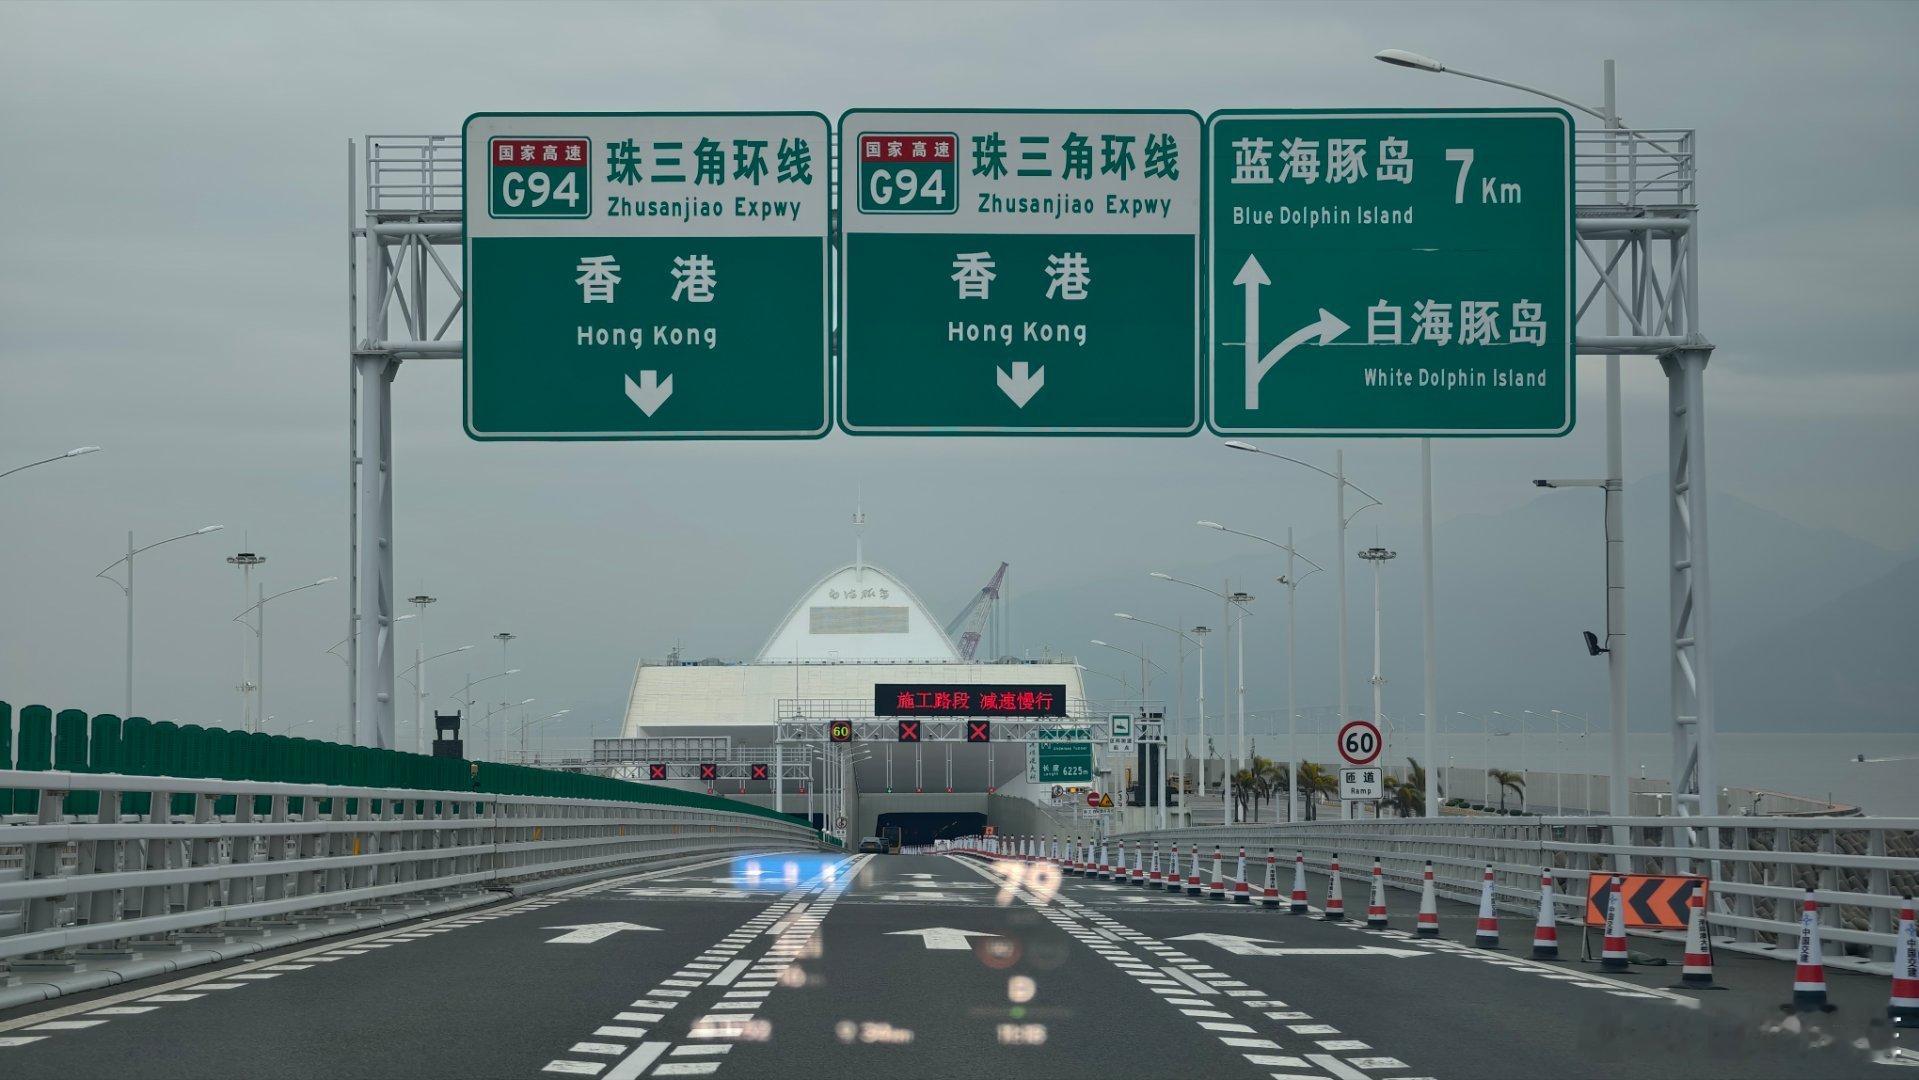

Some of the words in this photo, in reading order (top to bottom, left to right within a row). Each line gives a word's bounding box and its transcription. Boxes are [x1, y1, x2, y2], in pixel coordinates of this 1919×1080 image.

[499, 145, 581, 161] 国家高速
[607, 137, 812, 185] 珠三角环线
[866, 141, 950, 158] 国家高速
[972, 132, 1179, 181] 珠三角环线
[1231, 136, 1413, 184] 蓝海豚岛
[871, 169, 945, 204] G94
[1446, 149, 1473, 204] 7
[1483, 177, 1521, 203] Km
[503, 172, 579, 207] G94
[608, 197, 722, 222] Zhusanjiao
[736, 197, 800, 221] Expwy
[979, 193, 1093, 219] Zhusanjiao
[1107, 195, 1170, 218] Expwy
[1234, 207, 1273, 224] Blue
[1281, 206, 1349, 228] Dolphin
[1358, 206, 1412, 224] Island
[575, 255, 717, 303] 香港
[951, 252, 1090, 299] 香港
[949, 322, 1012, 346] Hong
[1024, 322, 1086, 346] Kong
[1367, 299, 1547, 347] 白海豚岛
[578, 326, 642, 349] Hong
[654, 326, 716, 349] Kong
[1365, 368, 1412, 386] White
[1419, 368, 1485, 390] Dolphin
[1494, 369, 1545, 386] Island
[896, 691, 970, 710] 施工路段
[979, 692, 1053, 711] 减速慢行
[832, 725, 849, 737] 60
[1346, 732, 1374, 754] 60
[1350, 787, 1372, 795] Ramp
